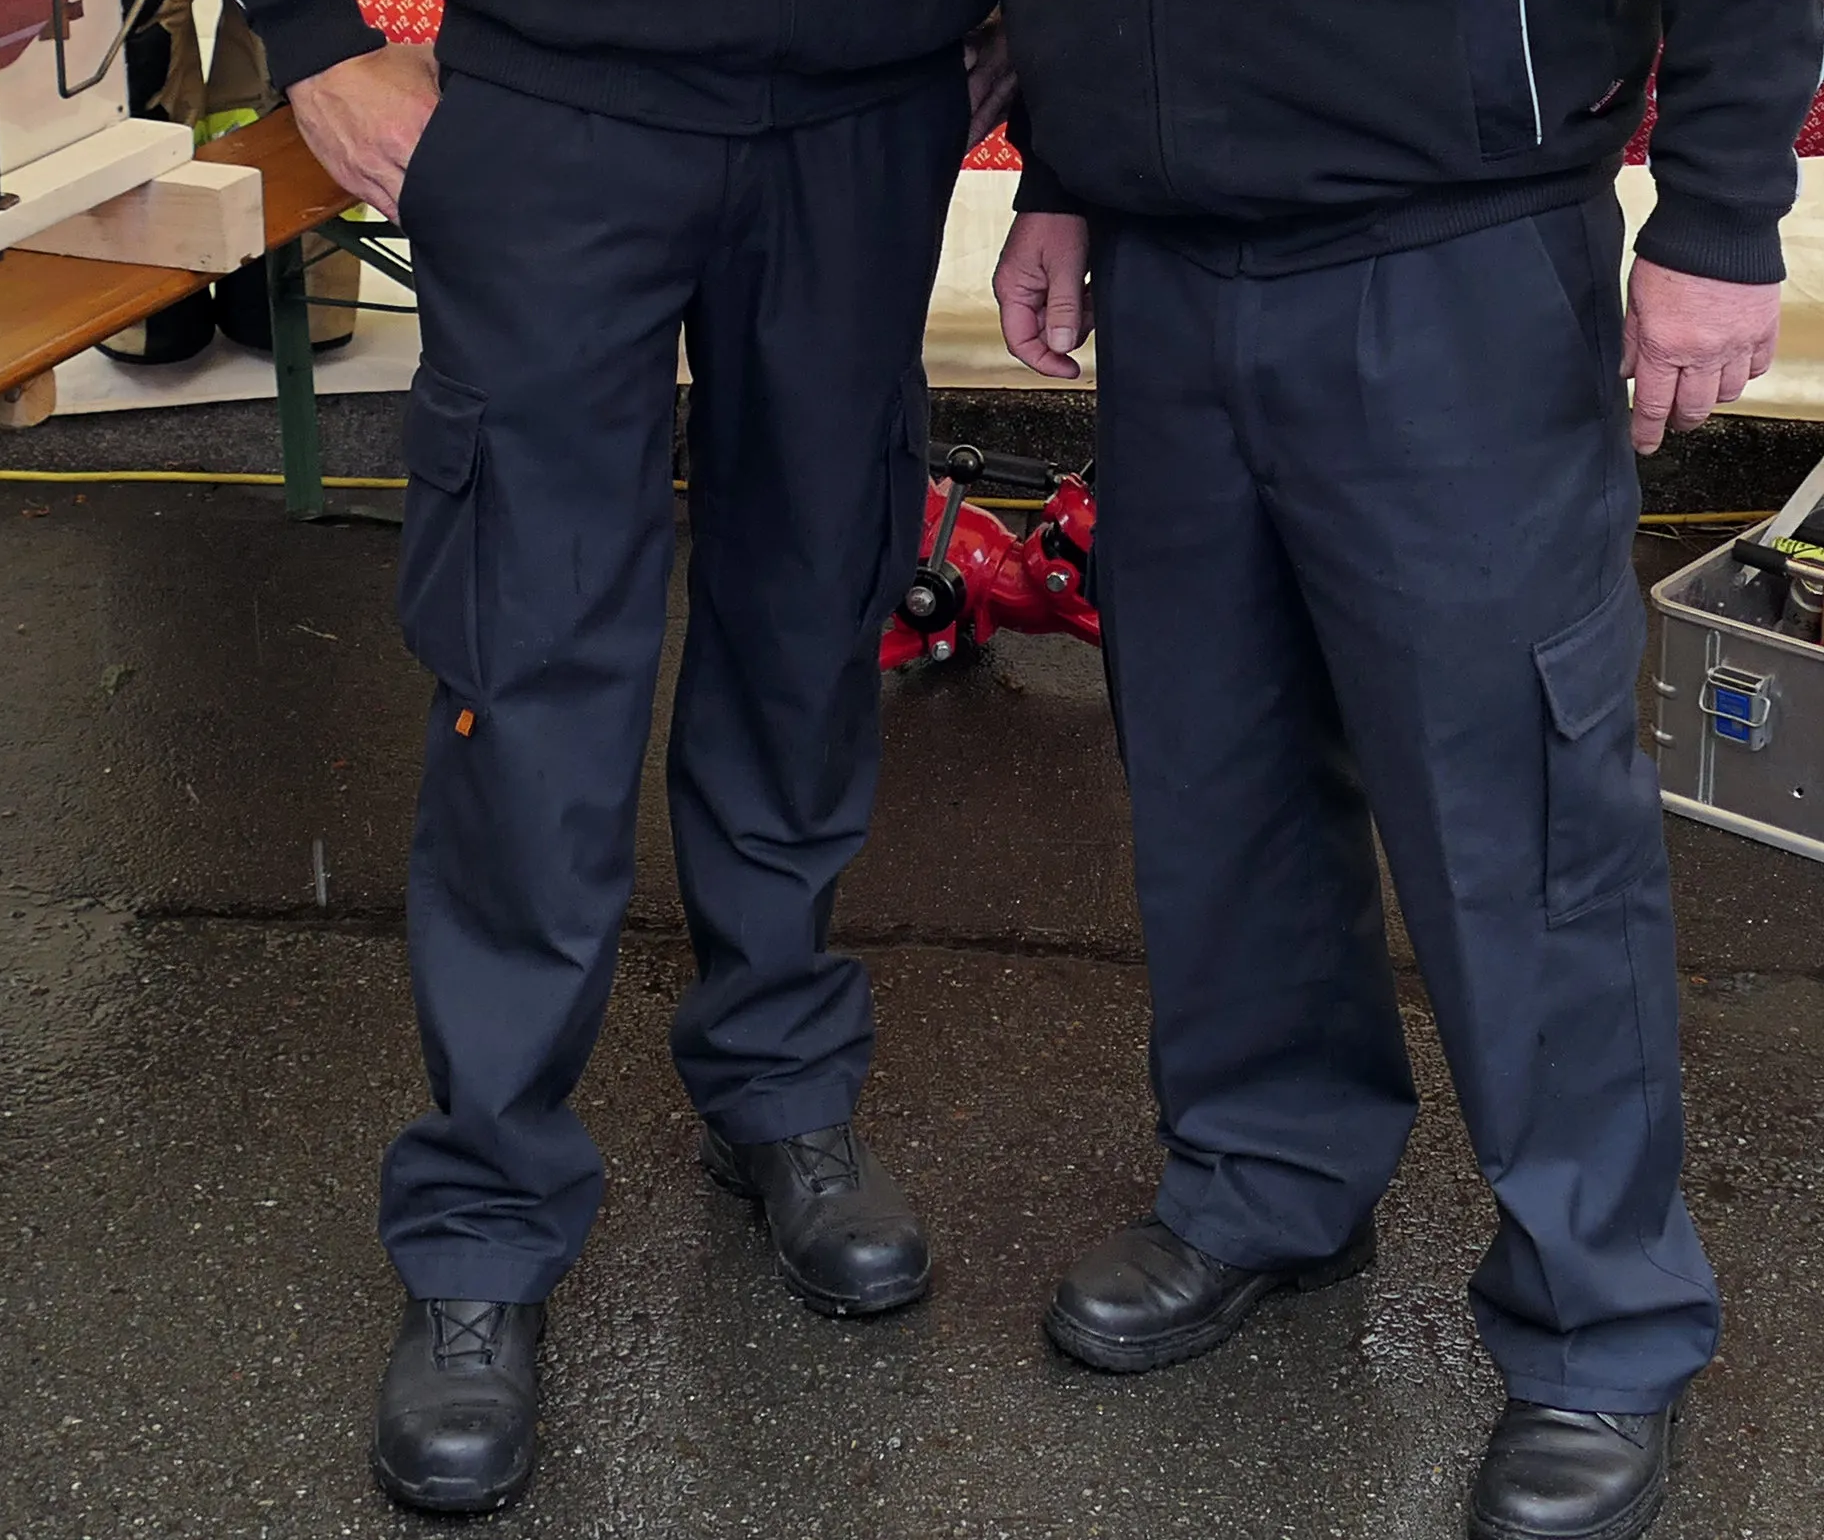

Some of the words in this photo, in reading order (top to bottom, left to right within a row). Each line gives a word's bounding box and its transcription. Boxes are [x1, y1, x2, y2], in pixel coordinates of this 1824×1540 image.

[391, 15, 410, 34] 112
[412, 16, 431, 34] 112
[973, 147, 991, 165] 112
[994, 148, 1011, 165] 112
